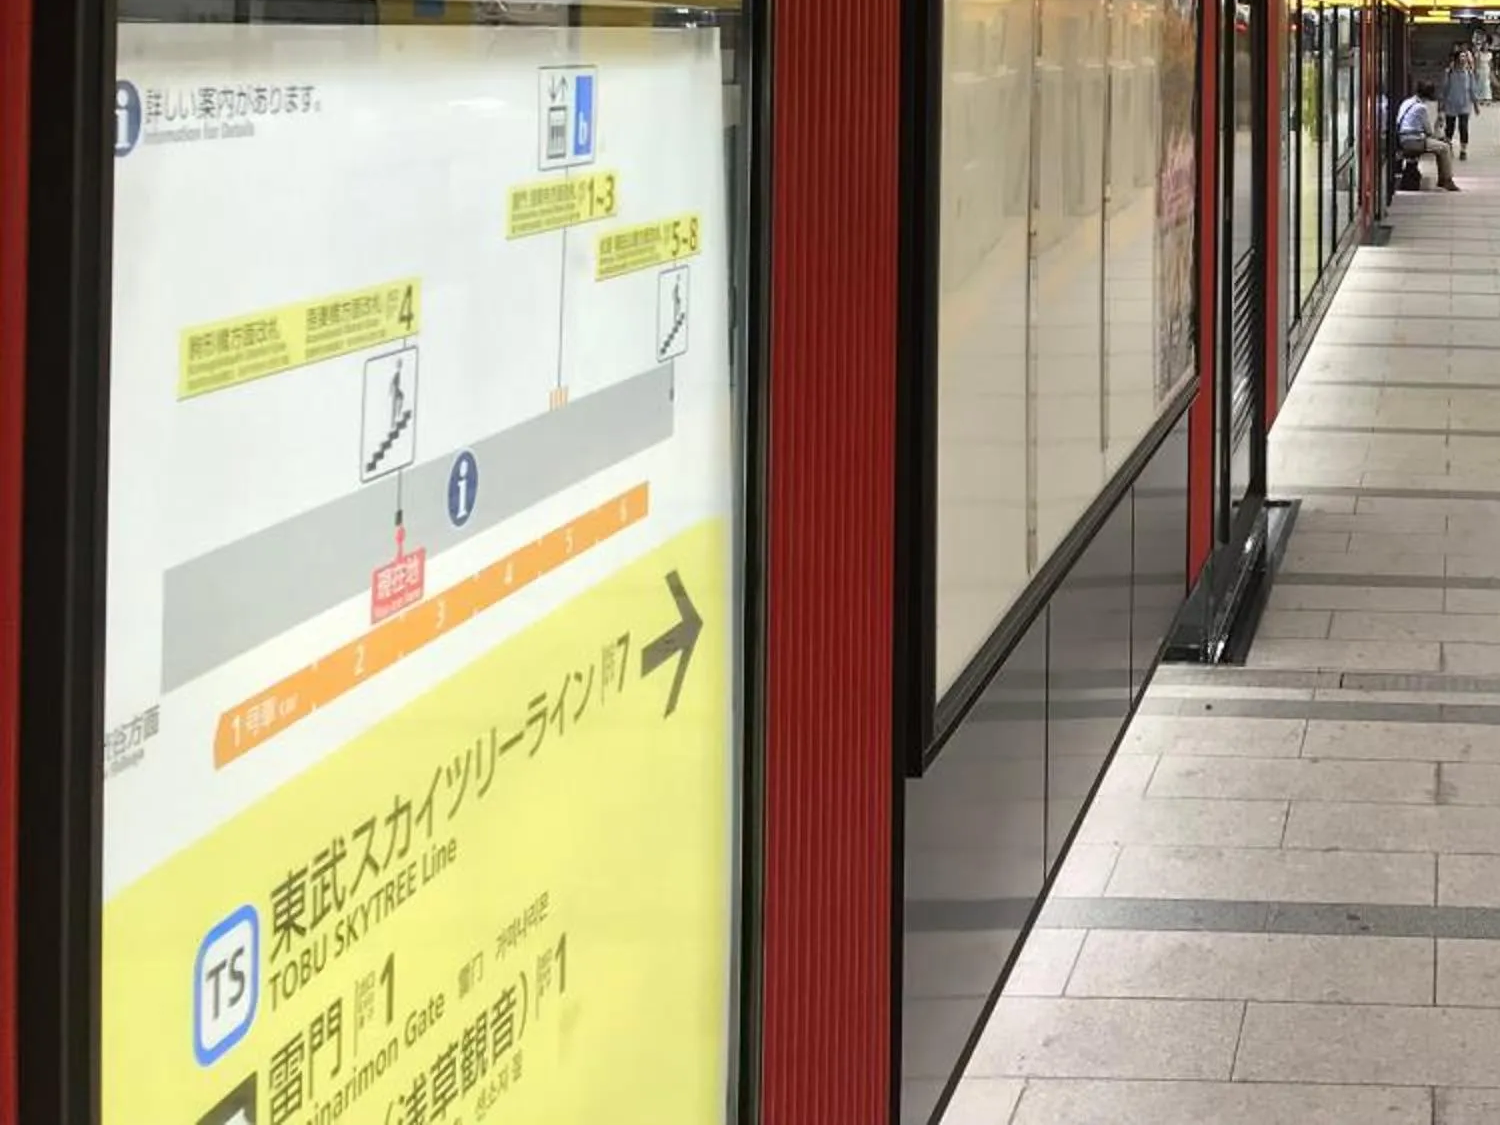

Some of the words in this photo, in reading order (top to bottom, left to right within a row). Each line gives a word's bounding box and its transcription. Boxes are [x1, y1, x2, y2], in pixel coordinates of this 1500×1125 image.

[398, 284, 414, 332] 4
[353, 644, 365, 676] 2
[270, 663, 595, 963] 東武スカイツリーライン
[617, 631, 630, 693] 7
[268, 933, 328, 1011] TOBU
[334, 861, 417, 960] SKYTREE
[422, 837, 457, 886] Line
[554, 933, 566, 994] 1
[206, 947, 245, 1021] TS
[269, 997, 342, 1125] 雷門
[380, 952, 394, 1026] 1
[306, 1036, 399, 1125] inarimon
[404, 993, 445, 1048] Gate
